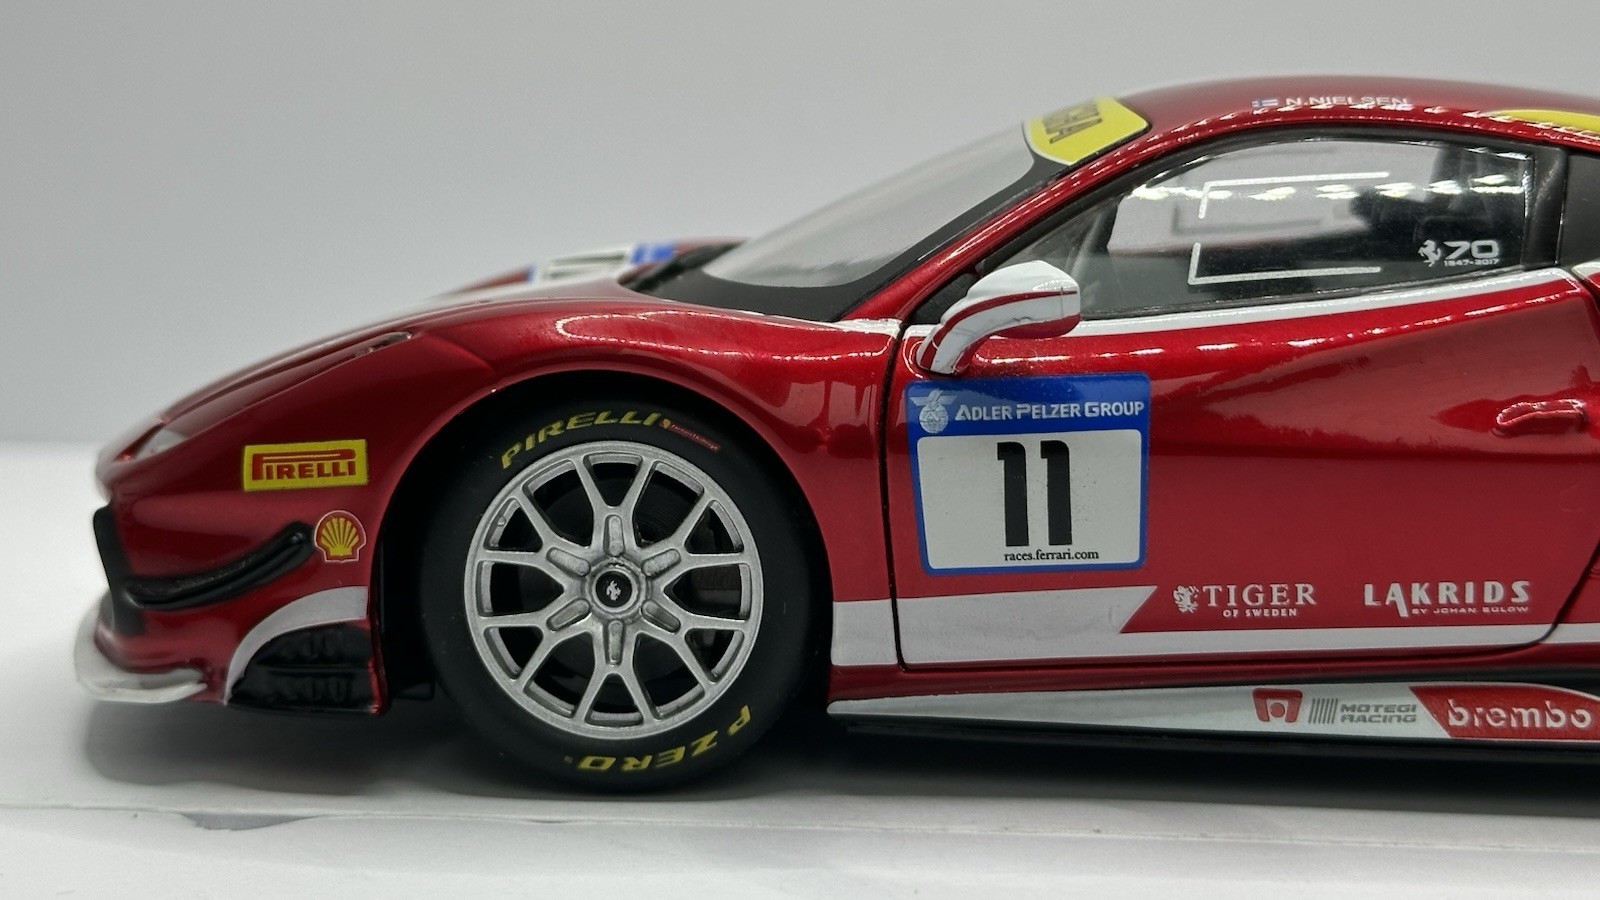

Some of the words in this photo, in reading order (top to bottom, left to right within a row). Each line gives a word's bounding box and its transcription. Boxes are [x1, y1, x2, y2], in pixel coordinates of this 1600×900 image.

[1443, 240, 1499, 260] 70
[955, 404, 1013, 421] ADLER
[1016, 402, 1082, 419] PELZER
[1085, 401, 1145, 418] GROUP
[501, 410, 662, 470] PIRELLI
[251, 448, 357, 481] PIRELLI
[996, 439, 1073, 548] 11
[1004, 549, 1100, 562] races.ferrari.com
[1202, 583, 1317, 608] TIGER
[1364, 580, 1531, 618] LAKRIDS
[1222, 610, 1239, 618] OF
[1245, 608, 1298, 618] SWEDEN
[1340, 704, 1417, 713] MOTEGI
[1340, 714, 1417, 724] RACING
[1448, 699, 1592, 729] brembo
